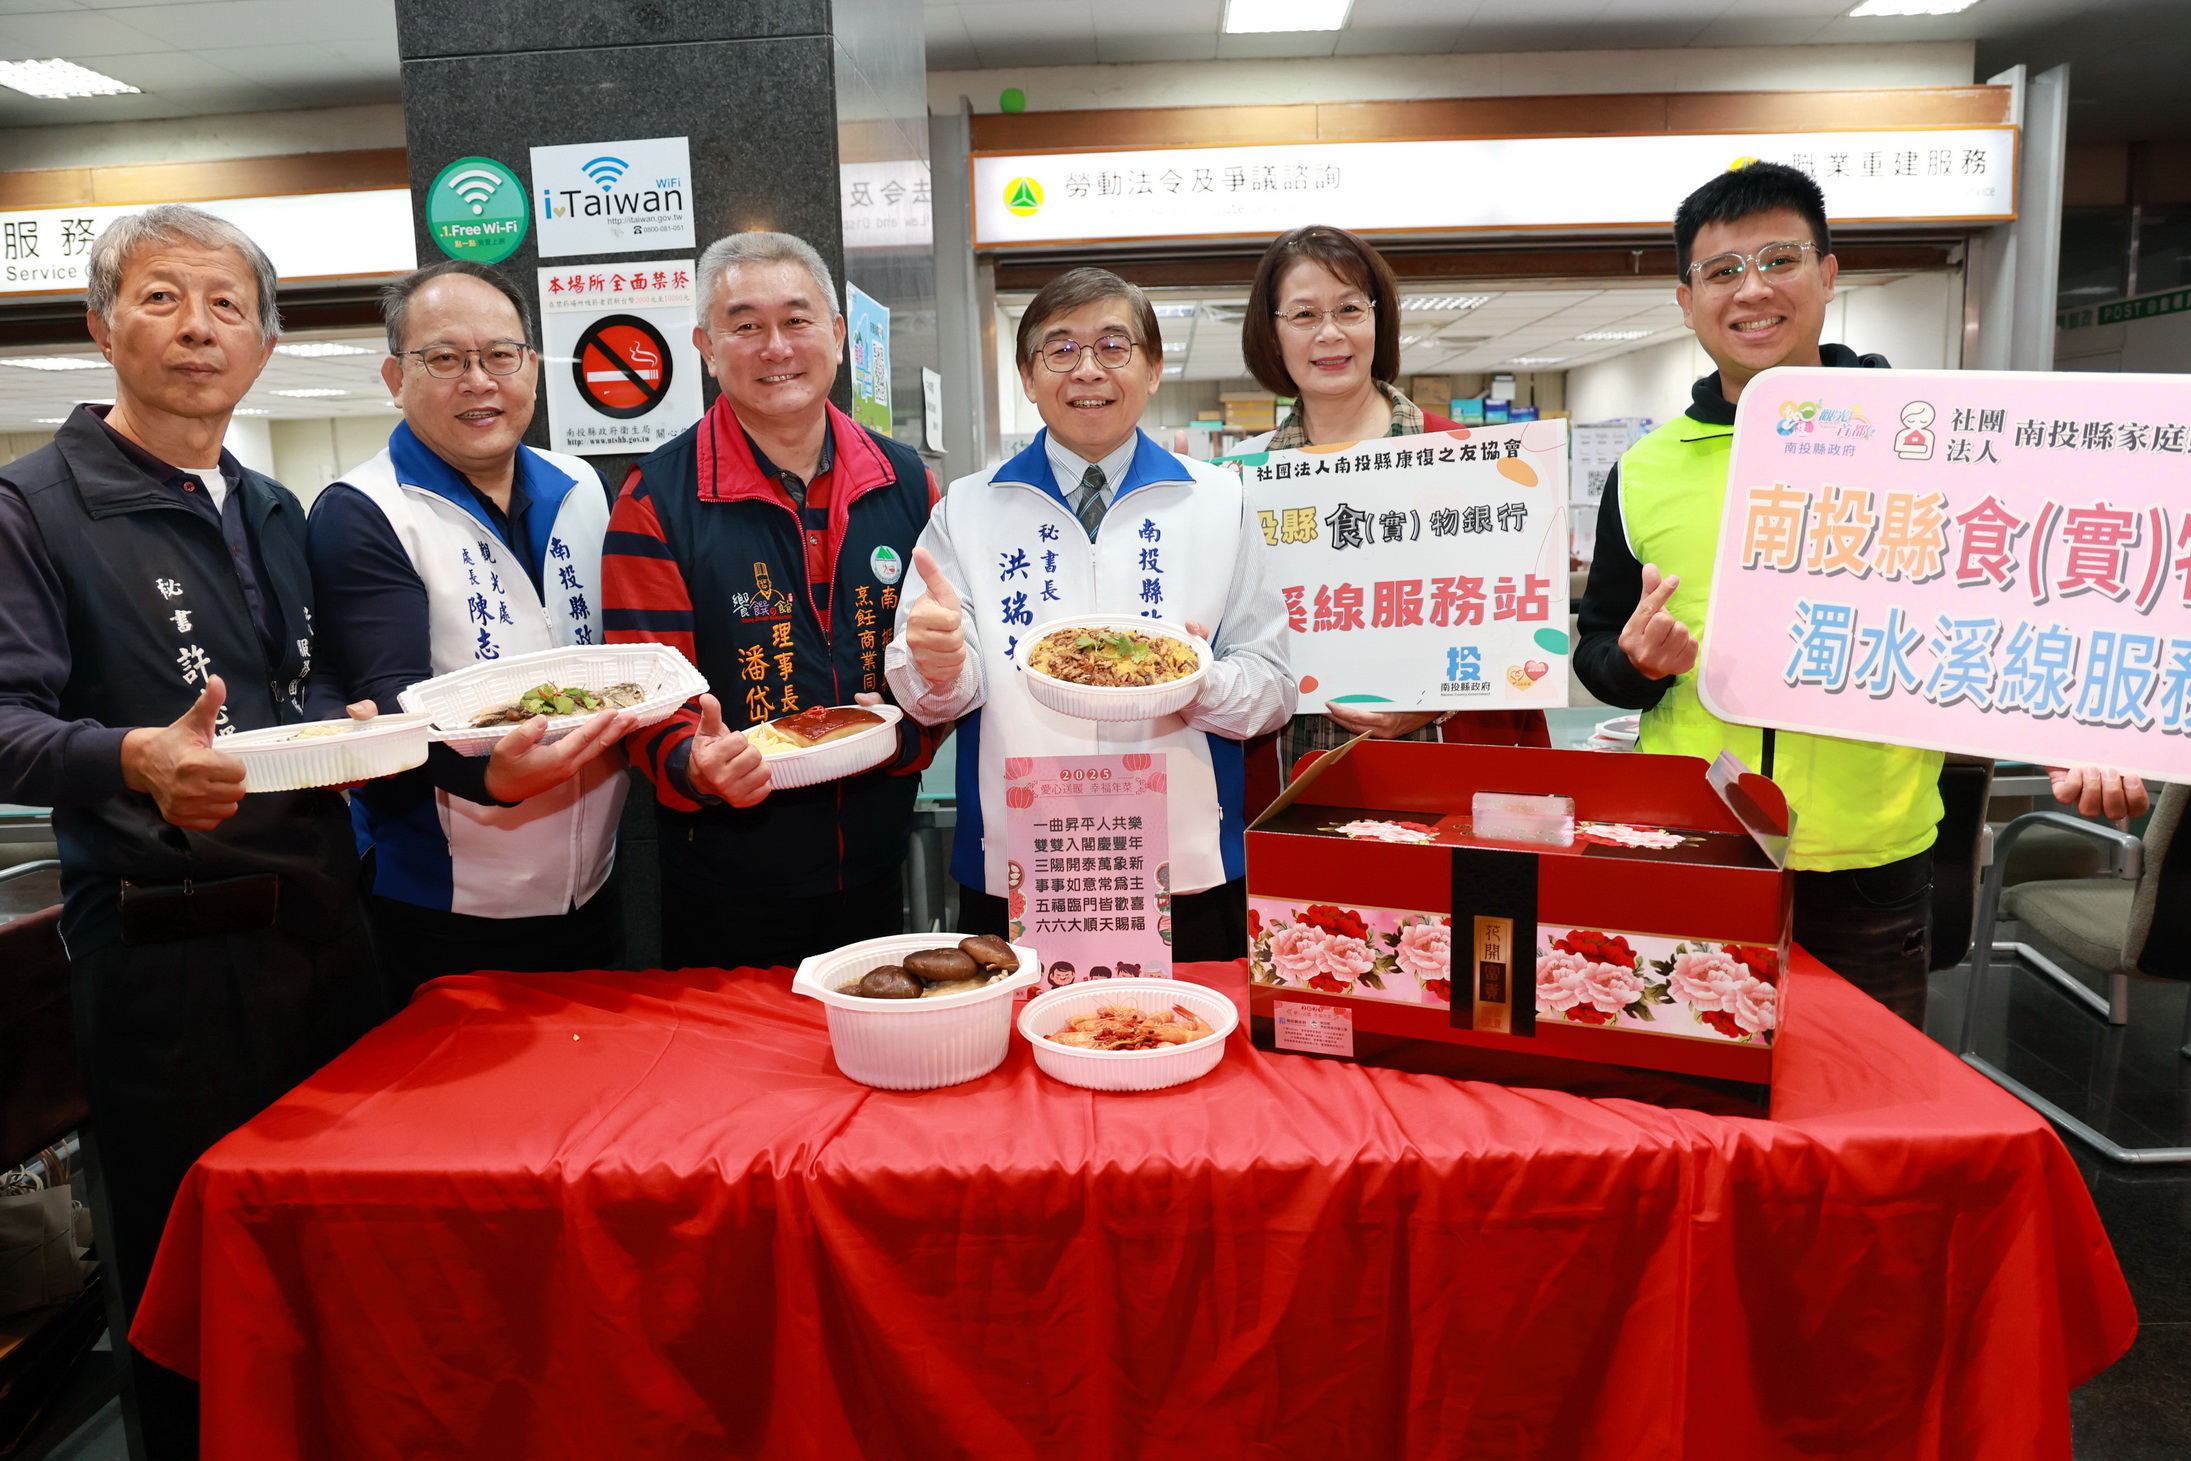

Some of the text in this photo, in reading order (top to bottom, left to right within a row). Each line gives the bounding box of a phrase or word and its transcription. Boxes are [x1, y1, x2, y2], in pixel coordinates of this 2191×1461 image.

[1793, 149, 1987, 178] 職業重建服務
[656, 177, 681, 188] WiFi
[1066, 164, 1340, 197] 勞動法令及爭議諮詢
[482, 220, 518, 234] Wi-Fi
[607, 214, 683, 225] http://itaiwan.gov.tw
[643, 224, 684, 233] 0800-081-051
[4, 219, 95, 260] 服務
[6, 264, 77, 281] Service
[548, 270, 690, 295] 本場所全面禁菸
[1951, 408, 2006, 433] 社團
[566, 425, 651, 438] 南投縣政府衛生局
[2014, 419, 2191, 454] 南投縣家庭
[1784, 442, 1856, 457] 南投縣政府
[1946, 439, 1999, 463] 法人
[1038, 523, 1061, 602] 秘書長
[772, 621, 800, 713] 理事長
[1440, 681, 1491, 692] 南投縣政府
[1060, 768, 1112, 781] 2025
[1040, 782, 1133, 795] 愛心送暖 幸福年菜
[1033, 816, 1143, 832] 一曲昇平人共樂
[1034, 836, 1143, 852] 雙雙入閣慶豐年
[1035, 856, 1144, 873] 三陽開泰萬象新
[1035, 896, 1145, 913] 五福臨門皆歡喜
[1036, 916, 1146, 933] 六六大順天賜福
